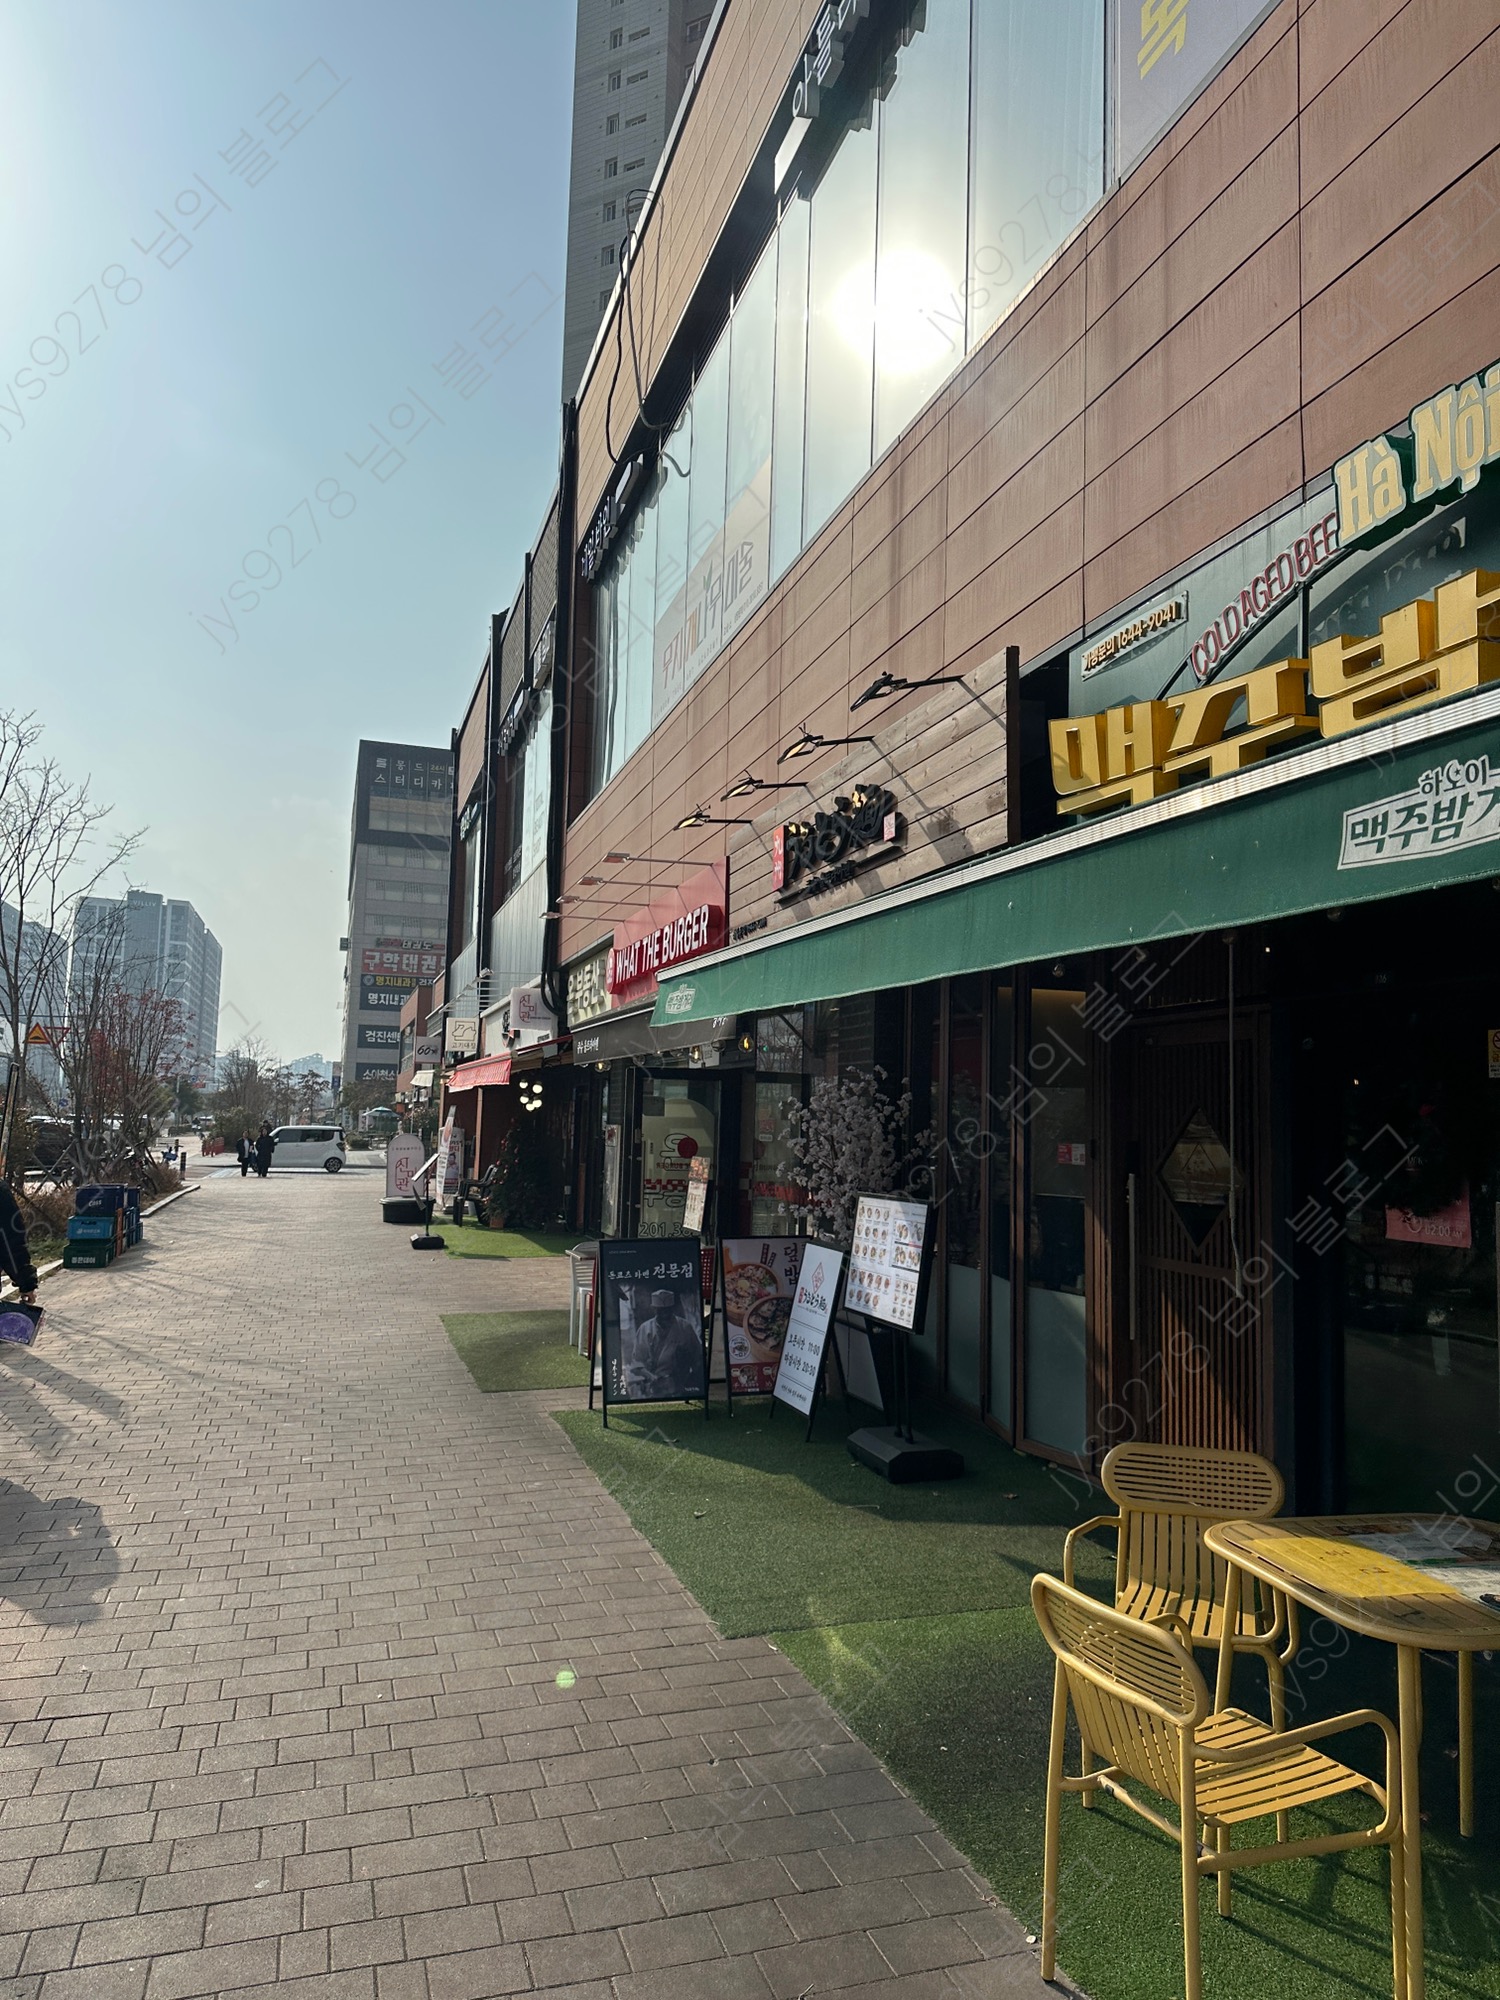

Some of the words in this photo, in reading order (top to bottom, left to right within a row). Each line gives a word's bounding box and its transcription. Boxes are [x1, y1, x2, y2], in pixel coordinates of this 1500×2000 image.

[792, 0, 858, 117] 아틀
[1336, 443, 1402, 541] Hà
[1084, 638, 1115, 669] 가맹문의
[1117, 601, 1177, 649] 1644-9041
[1190, 609, 1241, 681] COLD
[1240, 551, 1297, 630] AGED
[1048, 567, 1500, 815] 맥주밤
[373, 773, 454, 790] 스터디카
[364, 951, 445, 974] 구학태권
[375, 975, 411, 987] 명지내과
[615, 939, 641, 985] WHAT
[641, 928, 661, 973] THE
[661, 903, 710, 964] BURGER
[652, 1261, 693, 1279] 전문점
